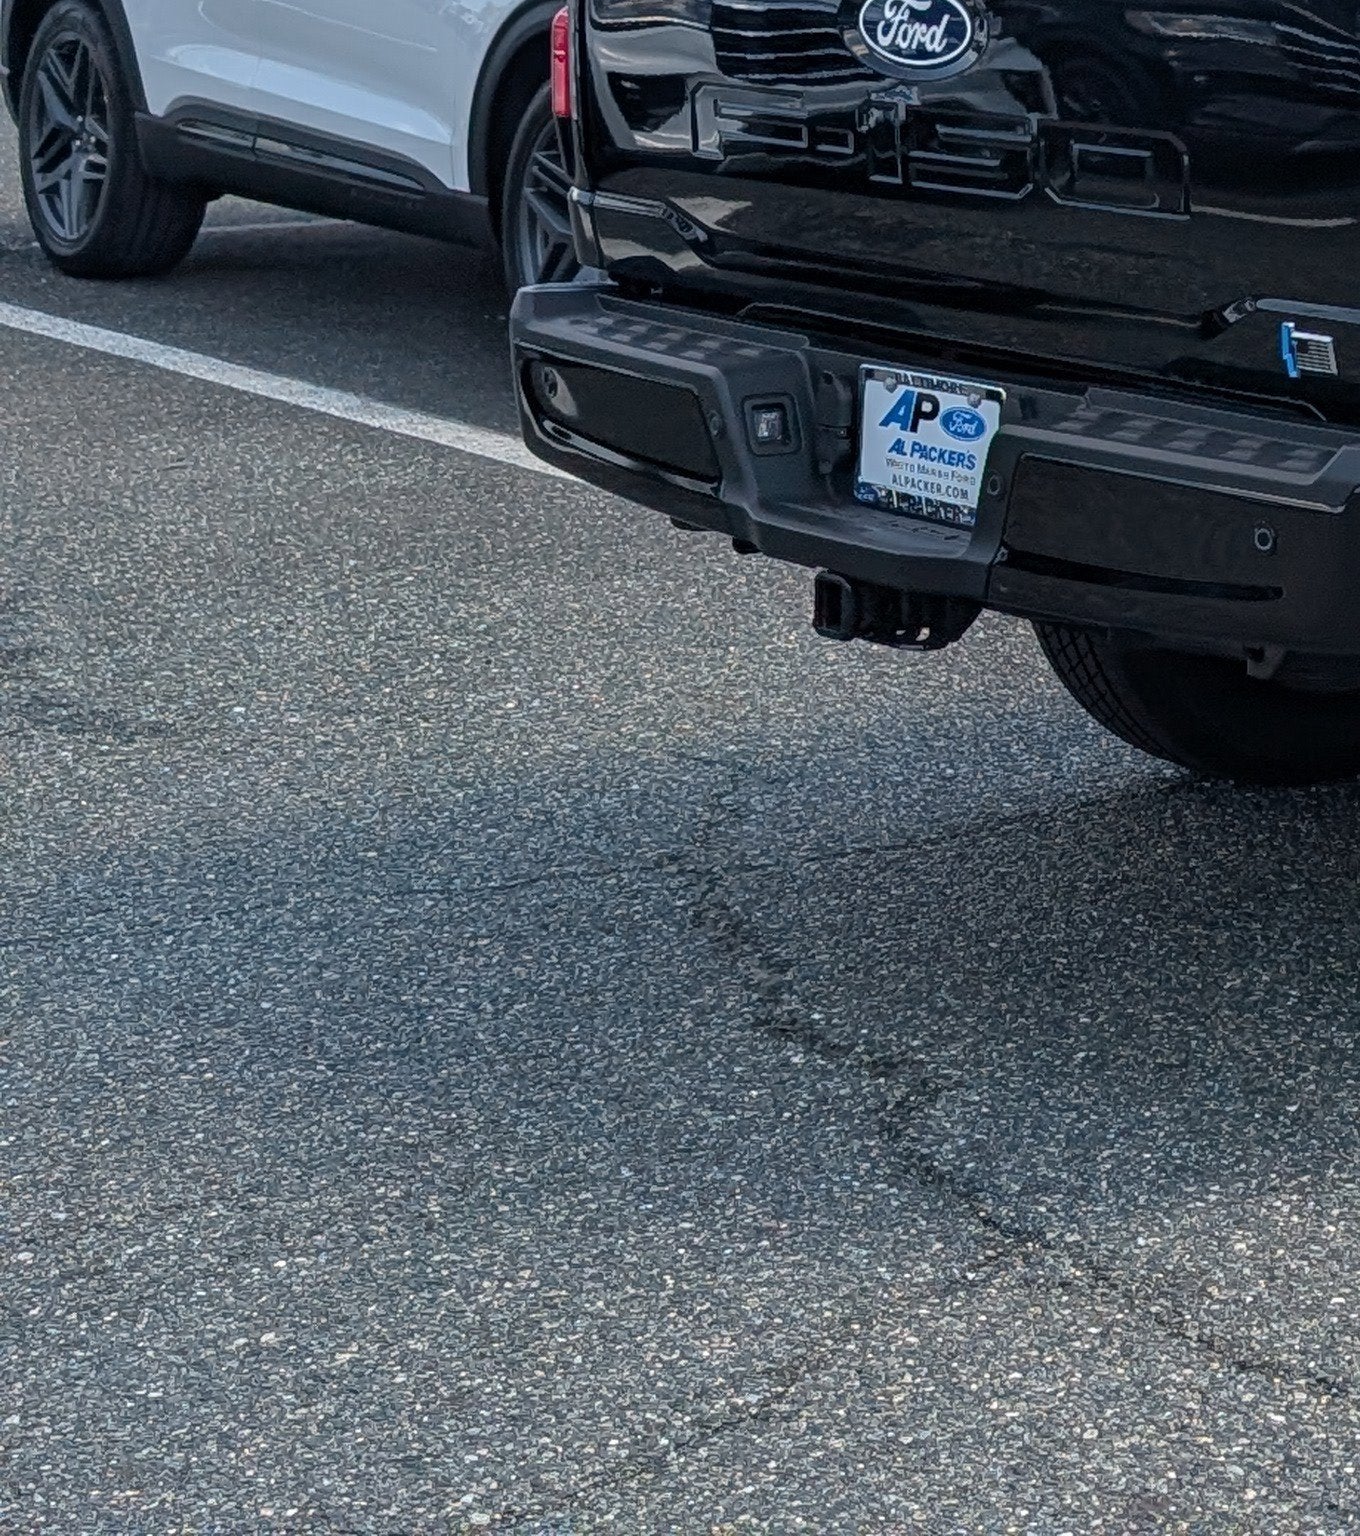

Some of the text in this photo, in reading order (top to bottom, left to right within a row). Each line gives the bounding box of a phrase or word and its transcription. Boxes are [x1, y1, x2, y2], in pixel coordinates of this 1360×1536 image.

[690, 79, 1192, 221] F-150
[878, 388, 980, 436] AP Ford
[887, 437, 978, 471] AL PACKER'S
[891, 473, 970, 501] ALPACKER.COM
